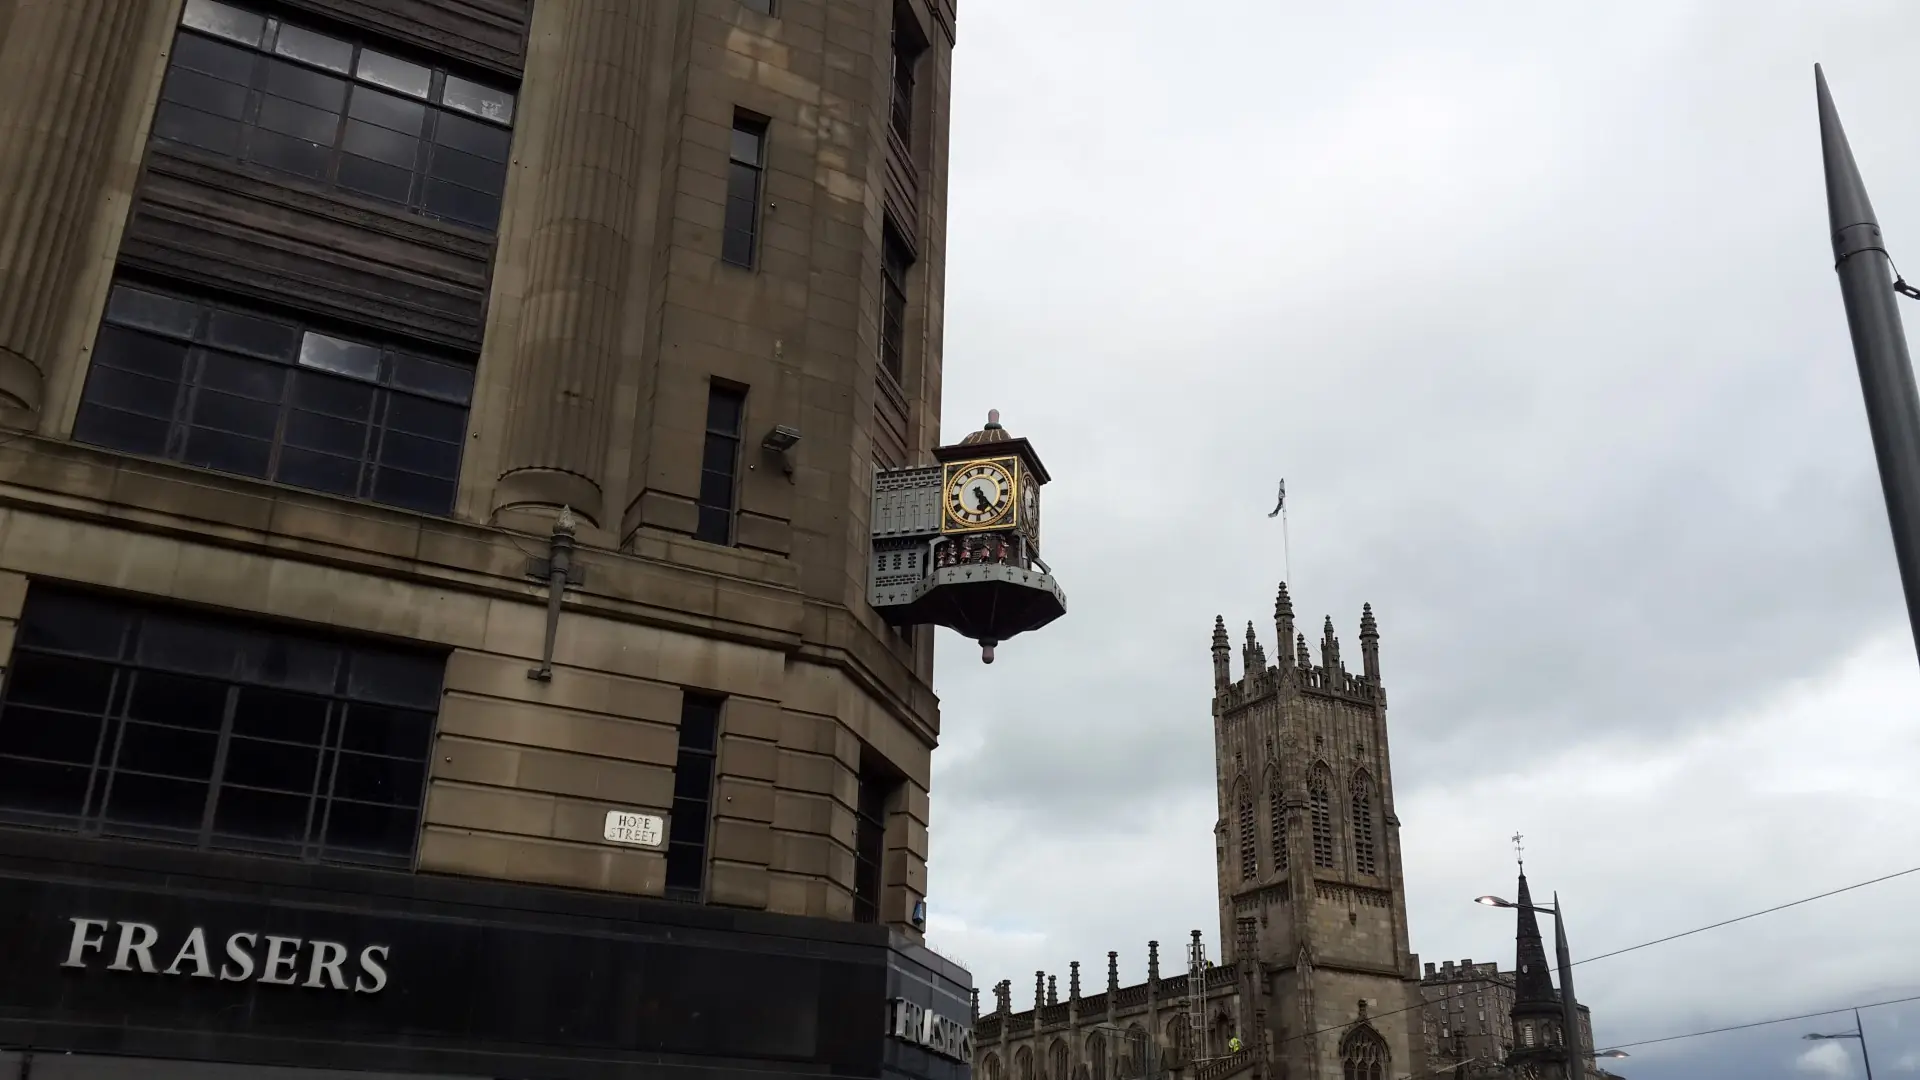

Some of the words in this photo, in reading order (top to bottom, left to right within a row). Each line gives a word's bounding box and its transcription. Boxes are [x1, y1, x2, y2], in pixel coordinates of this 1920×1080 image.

[619, 815, 651, 829] HOPE
[609, 827, 656, 842] STREET
[60, 917, 390, 993] FRASERS
